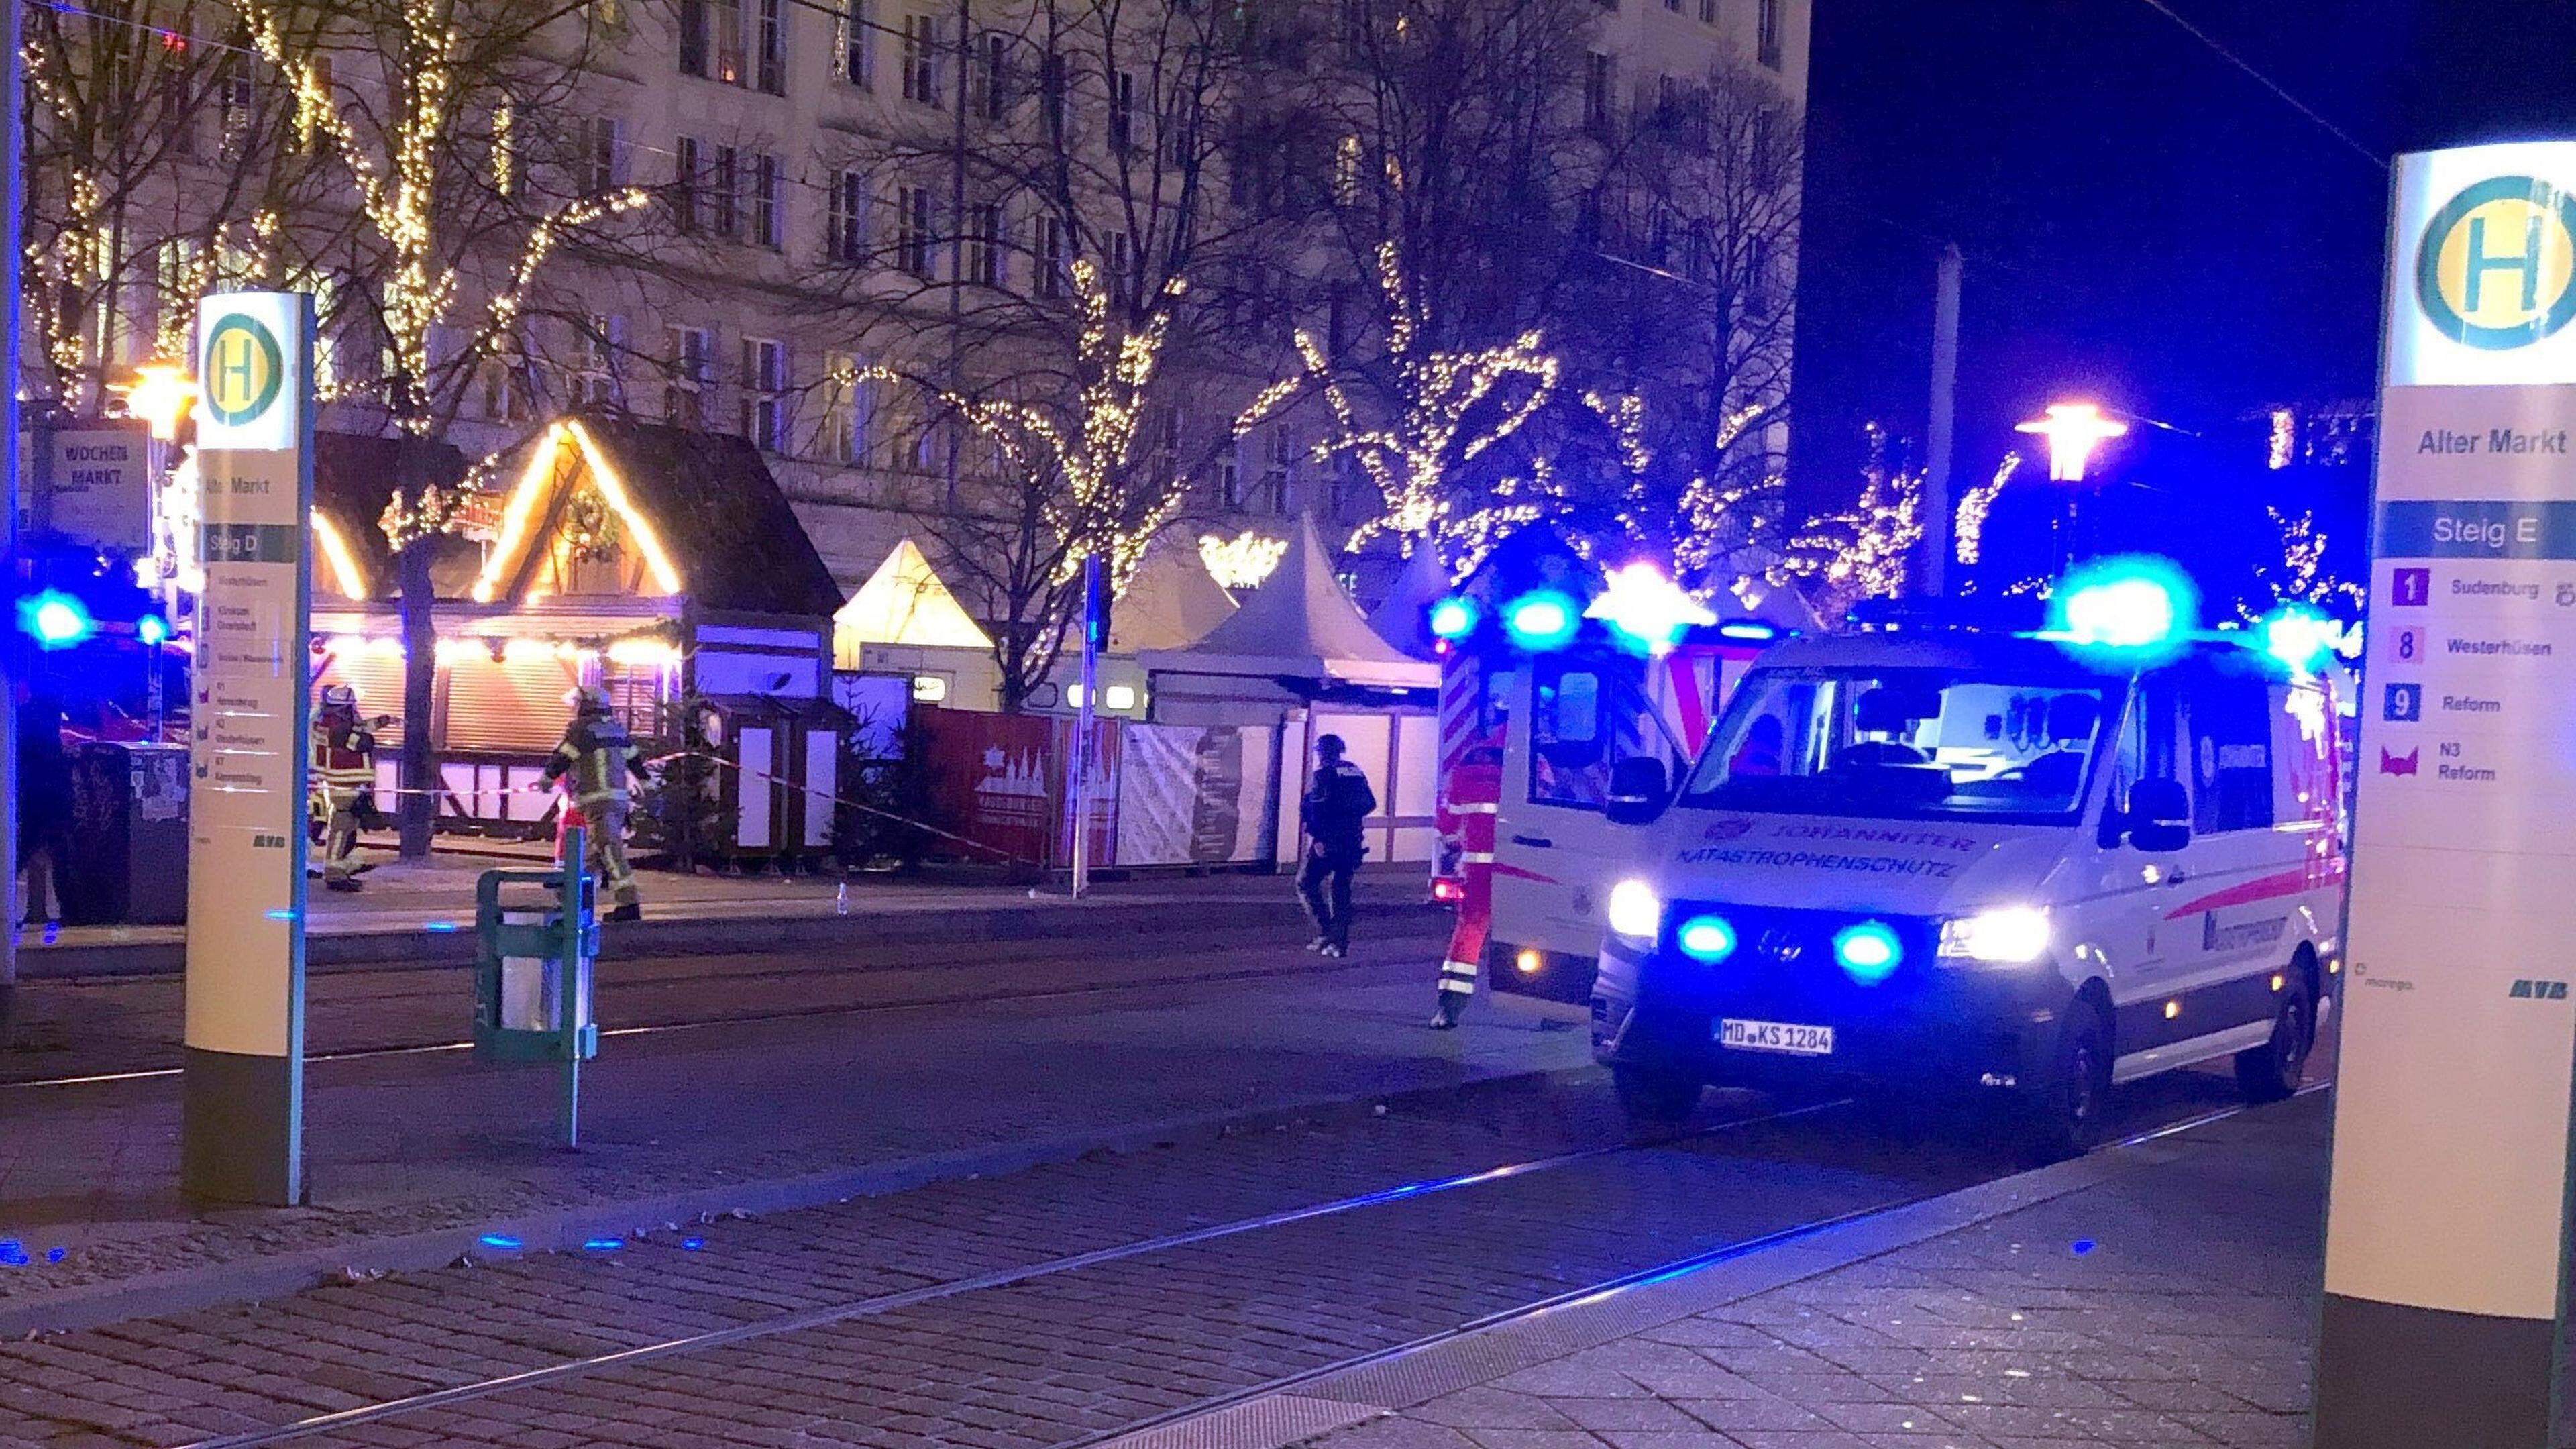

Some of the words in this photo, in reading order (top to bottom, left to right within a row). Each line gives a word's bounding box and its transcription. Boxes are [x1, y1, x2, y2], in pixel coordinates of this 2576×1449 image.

[2465, 216, 2542, 312] H
[219, 339, 252, 401] H
[66, 445, 129, 462] WOCHEN
[2418, 429, 2481, 455] Alter
[2488, 428, 2567, 455] Markt
[71, 469, 122, 485] MARKT
[231, 476, 270, 494] Markt
[244, 535, 258, 552] D
[2434, 517, 2506, 549] Steig
[2516, 517, 2538, 543] E
[2404, 573, 2416, 602] 1
[2452, 578, 2540, 600] Sudenburg
[2399, 631, 2414, 659] 8
[2447, 638, 2553, 656] Westerhüsen
[2395, 688, 2411, 716] 9
[2442, 696, 2501, 712] Reform
[2439, 742, 2461, 757] N3
[2438, 764, 2496, 780] Reform
[1770, 825, 1976, 852] JOHANNITER
[1675, 848, 1958, 878] KATASTROPHENSCHUTZ
[1722, 1022, 1746, 1042] MD
[1758, 1025, 1781, 1046] KS
[1784, 1027, 1829, 1051] 1284
